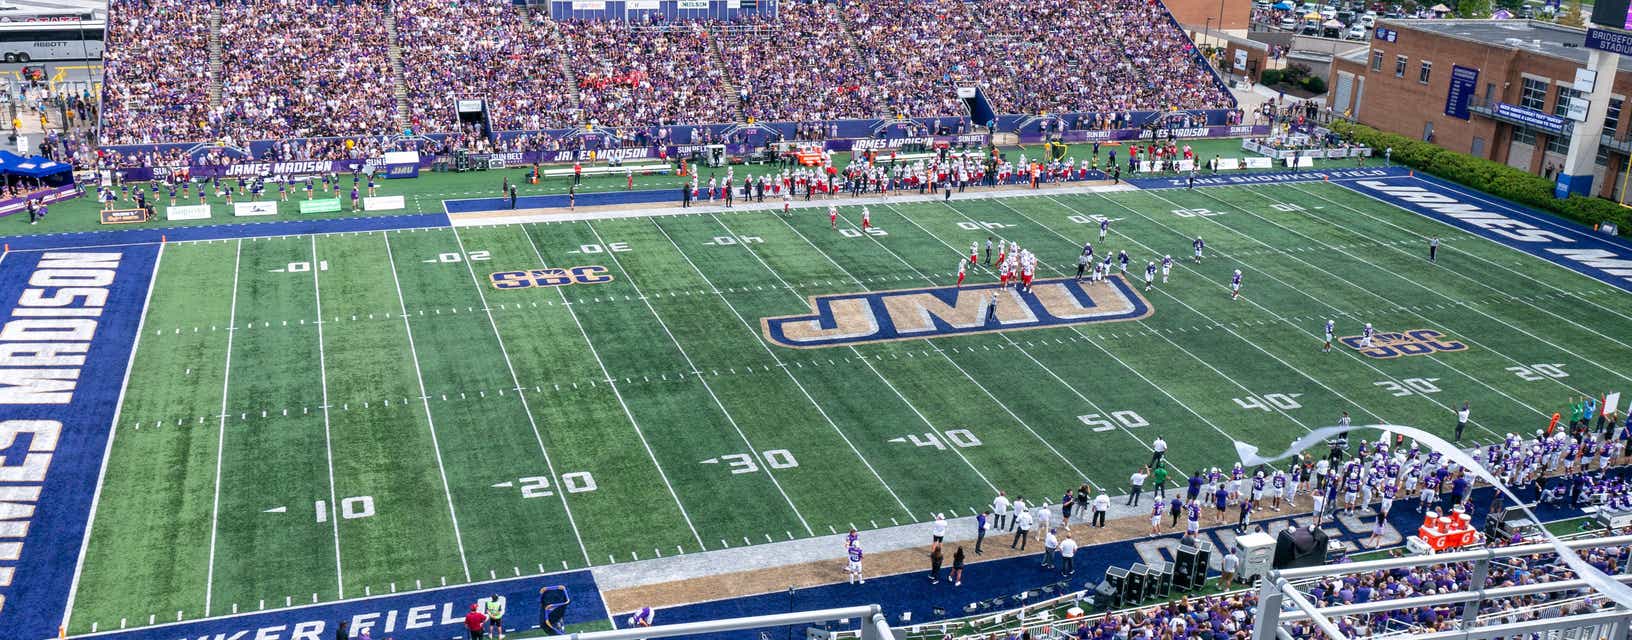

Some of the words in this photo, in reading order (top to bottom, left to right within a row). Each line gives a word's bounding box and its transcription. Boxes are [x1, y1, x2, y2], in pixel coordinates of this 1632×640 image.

[1600, 41, 1632, 54] STADIU
[852, 139, 886, 149] JAMES
[554, 150, 591, 161] JAES
[226, 164, 270, 175] JAMES
[274, 161, 332, 173] MADISON
[391, 166, 413, 174] JMU
[1230, 172, 1328, 183] SHOWKER
[1331, 170, 1387, 178] FIELD
[1356, 180, 1576, 242] JAMES
[839, 226, 888, 238] 50
[713, 234, 764, 246] 40
[580, 242, 632, 253] 30
[439, 250, 491, 262] 20
[288, 260, 328, 272] 10
[489, 265, 614, 289] SBC
[760, 273, 1155, 349] JMU
[1077, 410, 1150, 432] 50
[906, 428, 984, 451] 40
[721, 448, 799, 474] 30
[518, 471, 598, 499] 20
[315, 496, 375, 523] 10
[1133, 505, 1403, 572] DUS
[1437, 537, 1446, 547] G
